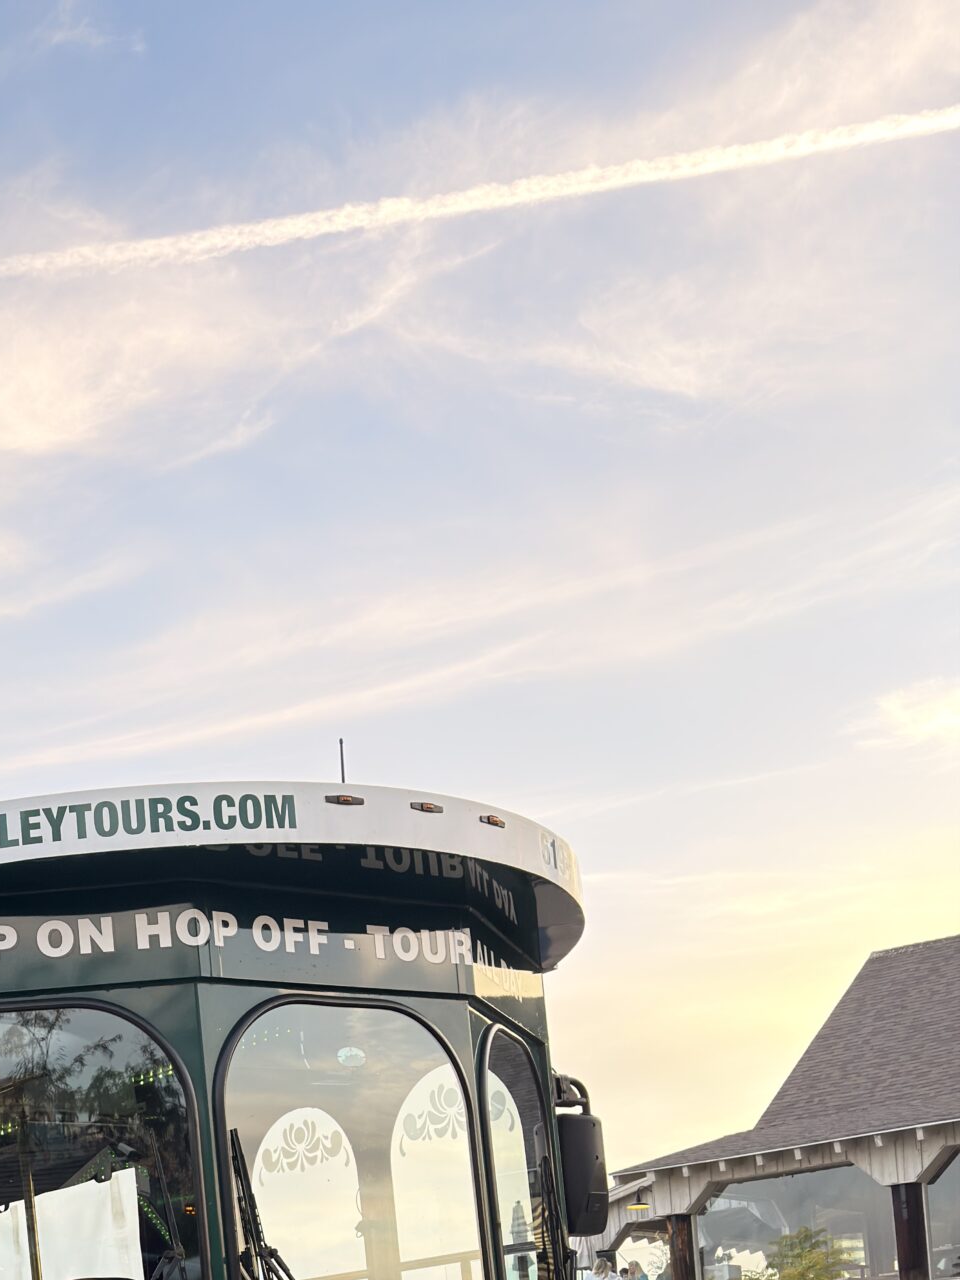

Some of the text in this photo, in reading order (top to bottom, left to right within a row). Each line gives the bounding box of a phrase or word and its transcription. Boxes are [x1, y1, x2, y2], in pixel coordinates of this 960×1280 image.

[36, 918, 115, 960] ON
[135, 908, 239, 951] HOP
[252, 914, 329, 955] OFF
[366, 924, 473, 966] TOUR
